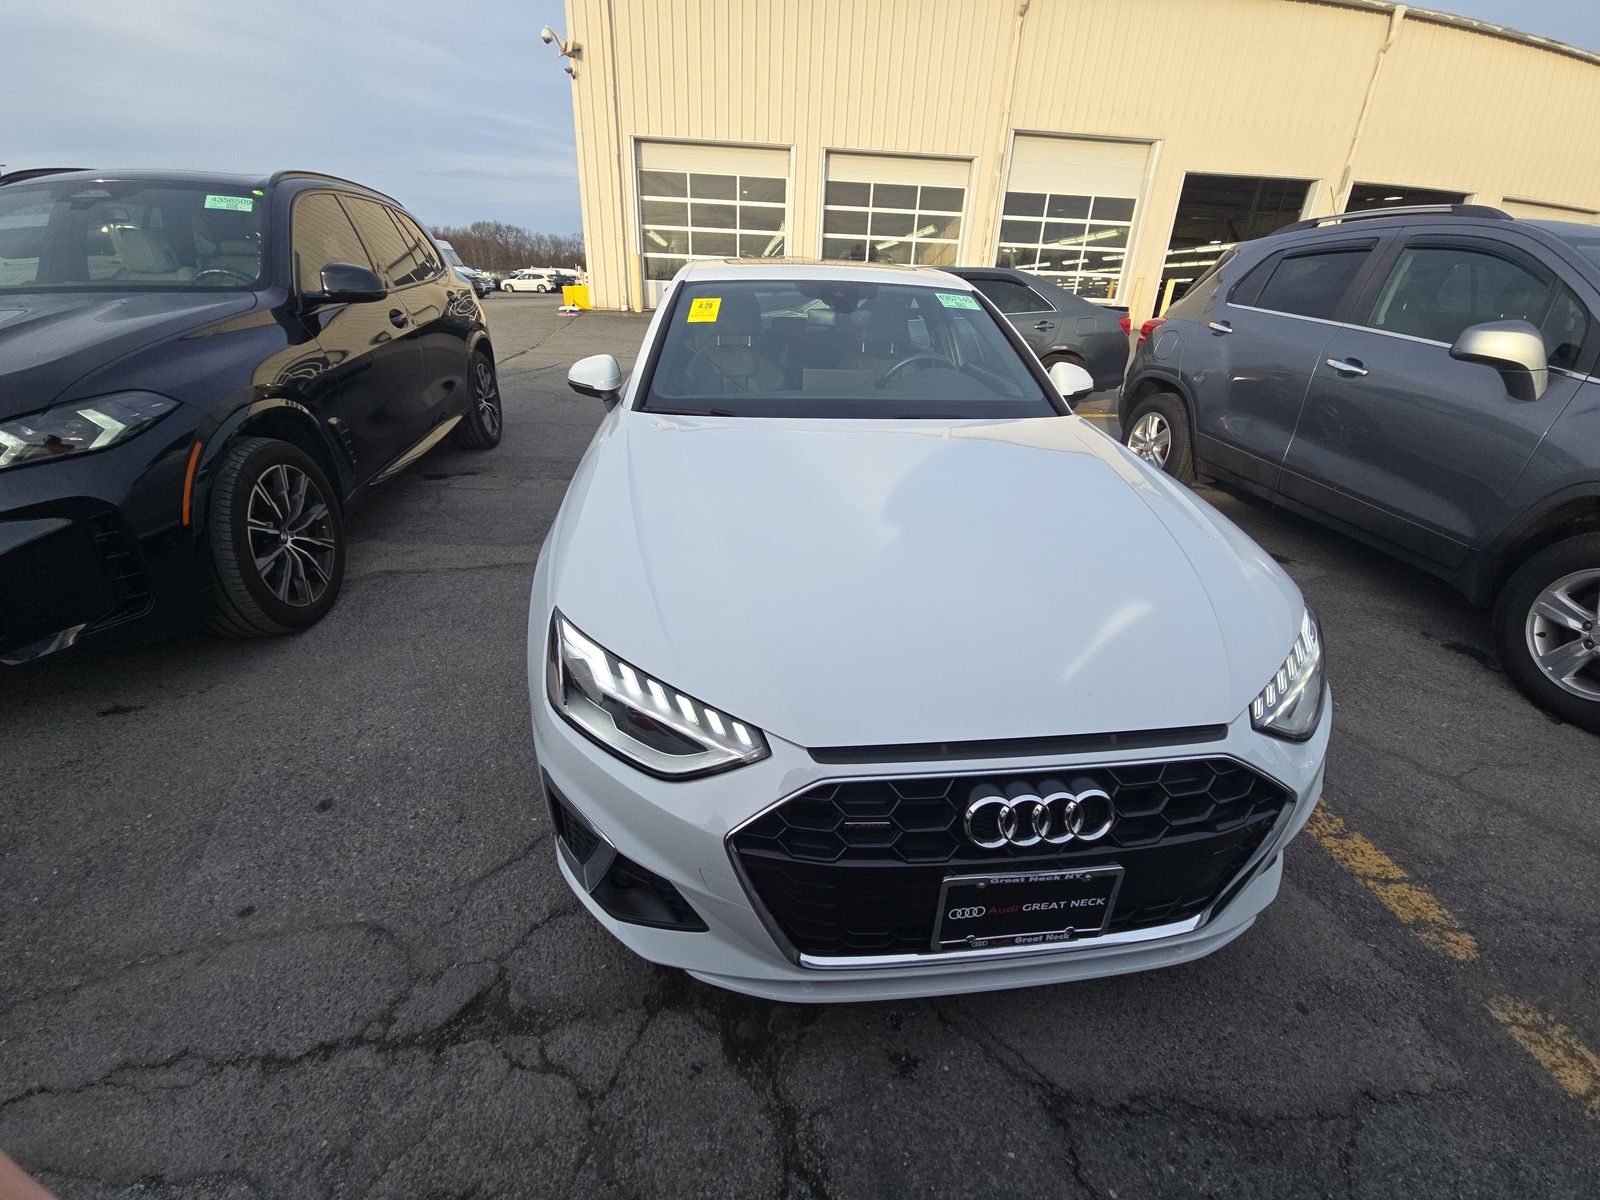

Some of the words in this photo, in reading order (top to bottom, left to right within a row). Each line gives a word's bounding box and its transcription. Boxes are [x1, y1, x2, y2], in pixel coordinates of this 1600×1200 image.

[989, 905, 1020, 914] Audi
[1022, 901, 1068, 912] GREAT
[1070, 897, 1106, 908] NECK
[1014, 936, 1044, 944] Great
[1045, 932, 1070, 941] Neck
